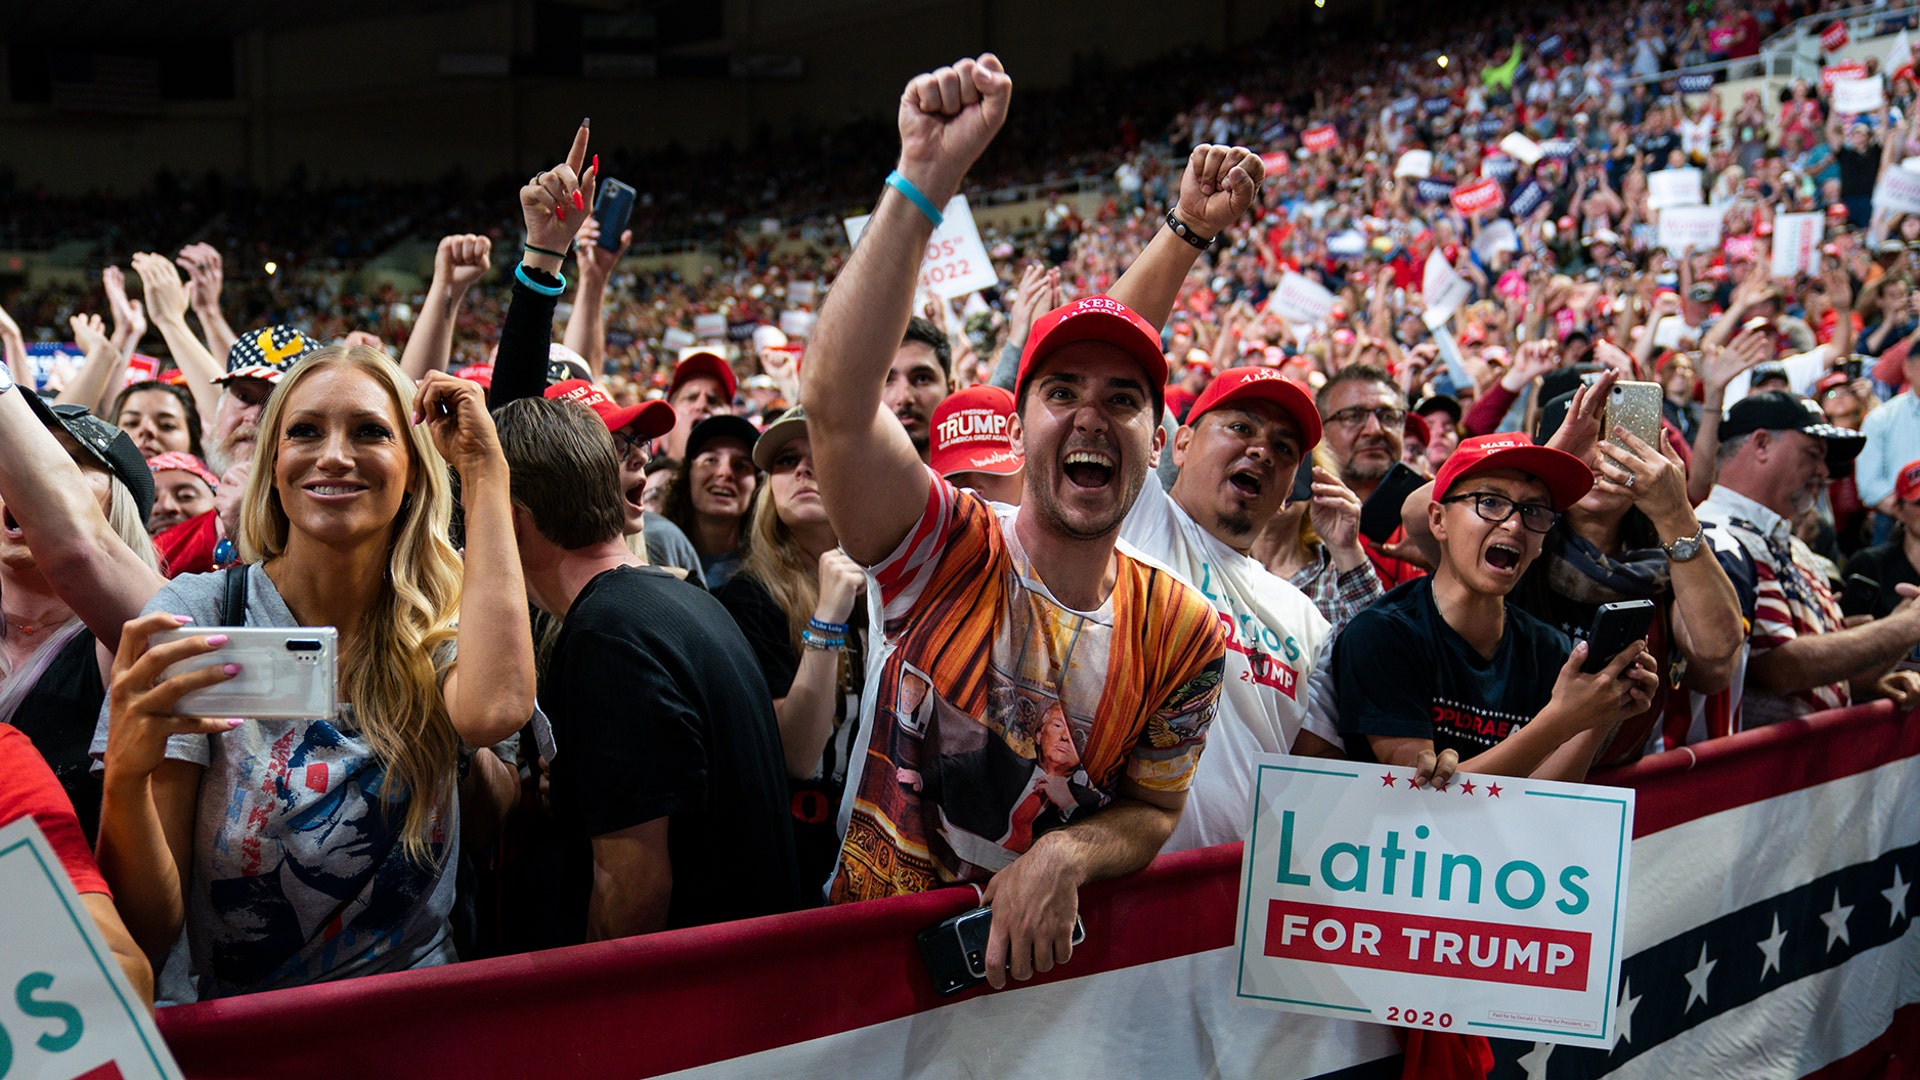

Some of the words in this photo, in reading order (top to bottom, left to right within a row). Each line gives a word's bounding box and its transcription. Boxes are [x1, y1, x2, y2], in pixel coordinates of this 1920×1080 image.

[1078, 298, 1126, 312] KEEP
[936, 414, 1007, 443] TRUMP
[1480, 440, 1516, 450] MAKE
[1277, 810, 1590, 915] Latinos
[1281, 914, 1382, 956] FOR
[1402, 927, 1575, 975] TRUMP
[1386, 1006, 1453, 1028] 2020
[1537, 1017, 1552, 1025] Trump
